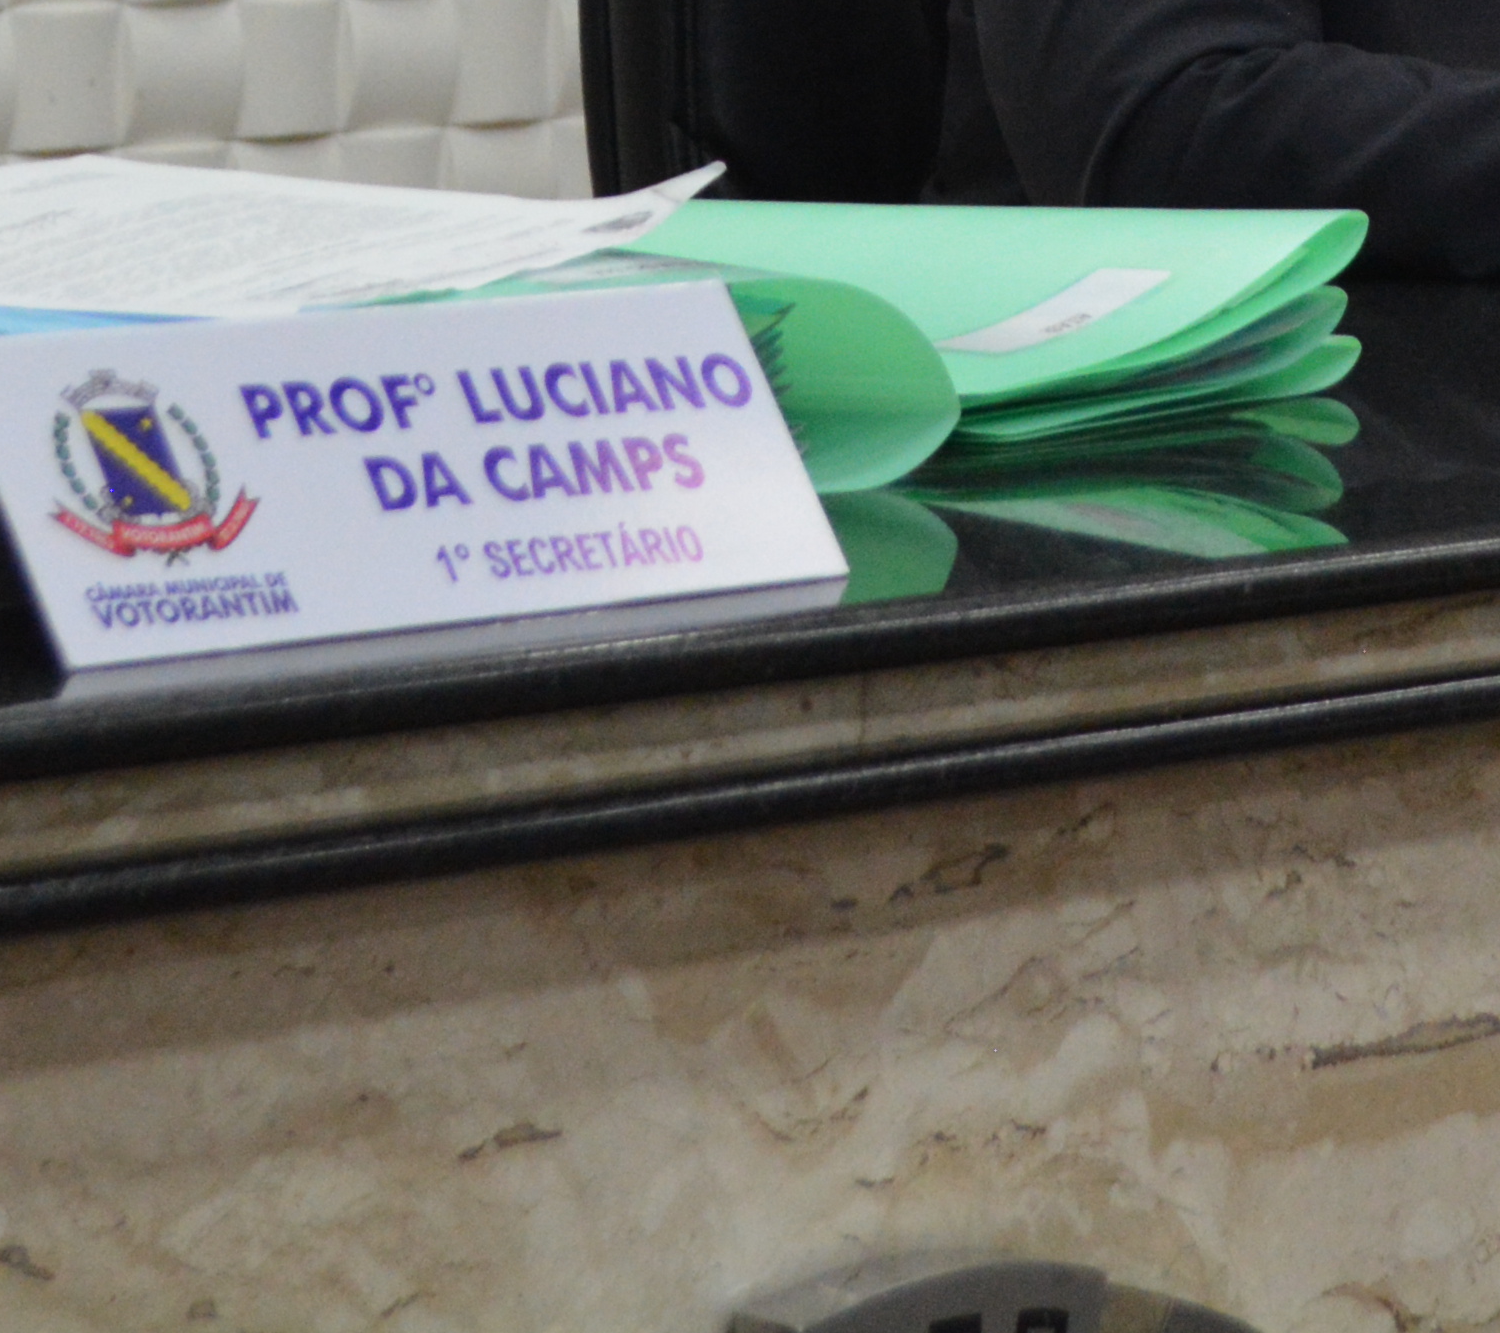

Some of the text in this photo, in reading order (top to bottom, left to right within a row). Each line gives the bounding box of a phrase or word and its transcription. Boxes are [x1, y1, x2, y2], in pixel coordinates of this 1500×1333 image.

[455, 351, 753, 425] LUCIANO
[362, 432, 706, 512] DA CAMPS
[482, 521, 705, 580] SECRETÁRIO
[85, 570, 290, 602] CÂMARA MUNICIPAL DE
[89, 587, 300, 629] VOTORANTIM
